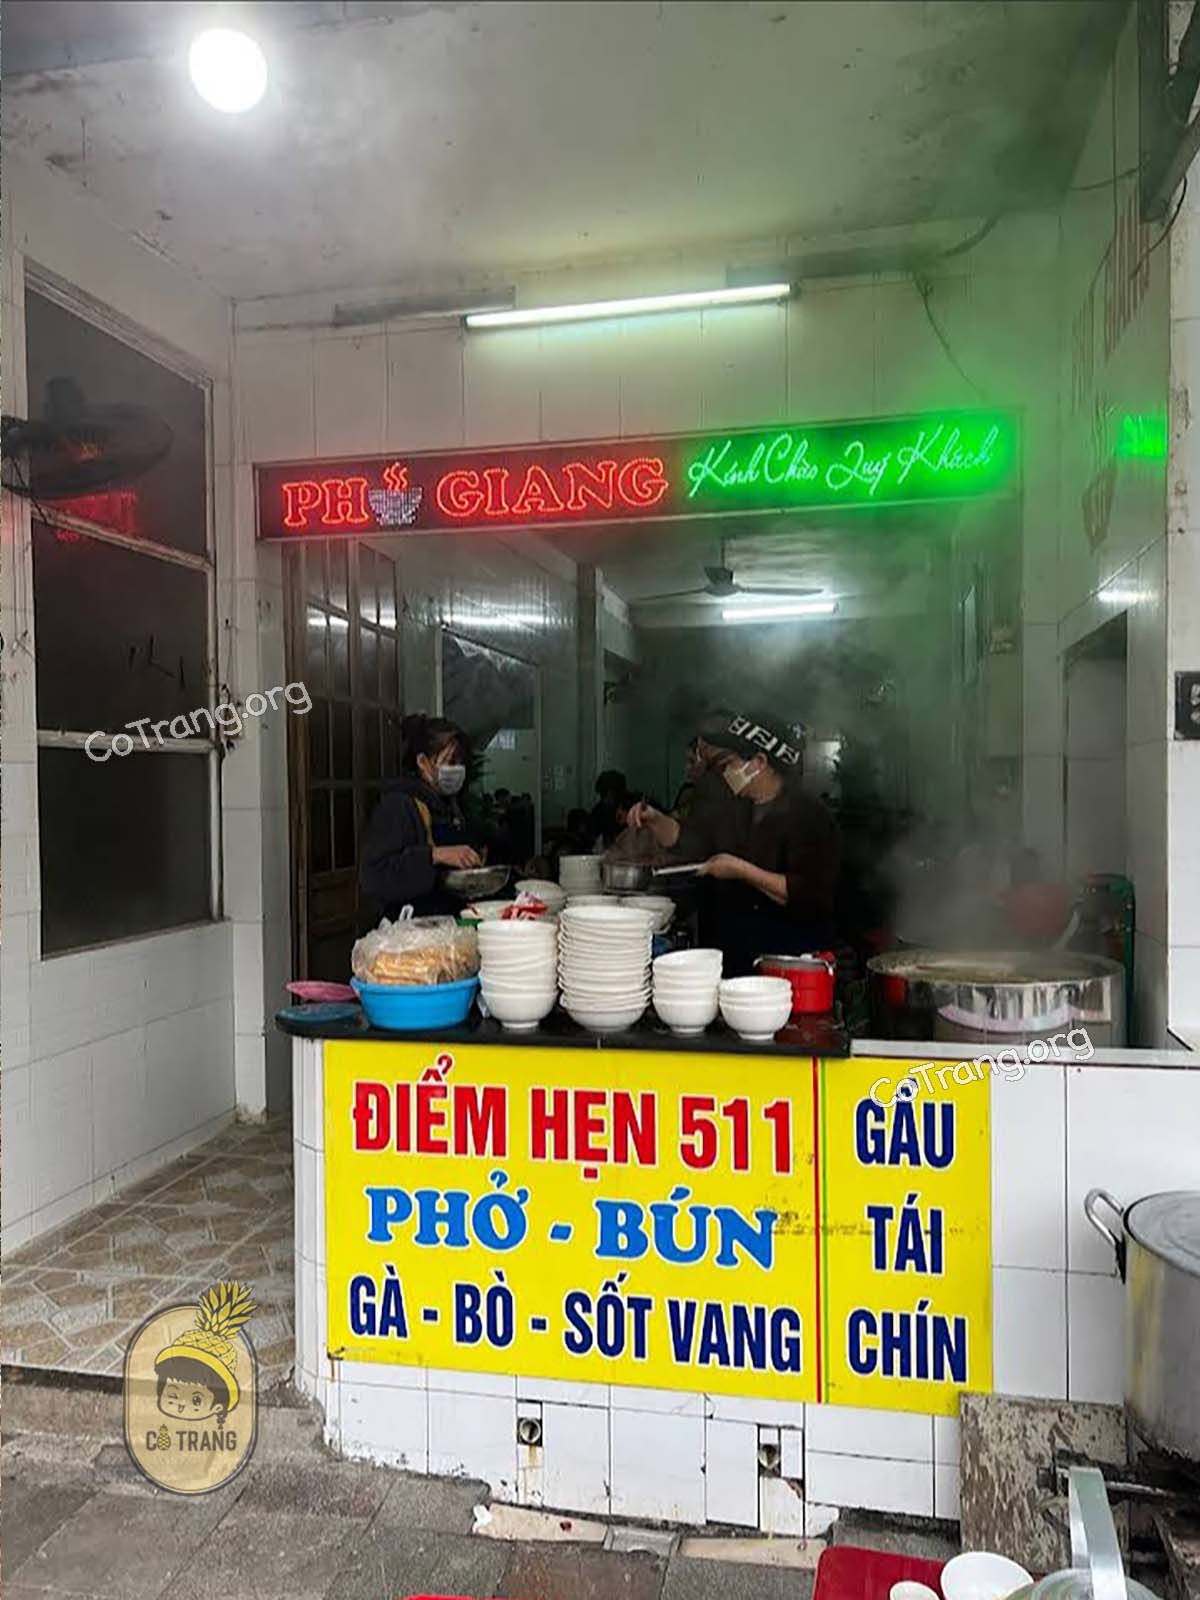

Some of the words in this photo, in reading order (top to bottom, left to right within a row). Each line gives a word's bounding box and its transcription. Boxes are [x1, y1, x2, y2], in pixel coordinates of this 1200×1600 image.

[436, 458, 668, 517] GIANG
[764, 433, 818, 484] Chào
[897, 424, 998, 484] Khách
[352, 1055, 507, 1157] ĐIỂM
[531, 1088, 657, 1179] HẸN
[680, 1096, 791, 1173] 511
[365, 1170, 529, 1250] PHỞ
[595, 1187, 778, 1270] BÚN
[867, 1193, 943, 1274] TÁI
[350, 1265, 407, 1338] GÀ
[455, 1271, 513, 1347] BÒ
[564, 1272, 653, 1359] SỐT
[668, 1300, 801, 1373] VANG
[848, 1300, 967, 1383] CHÍN
